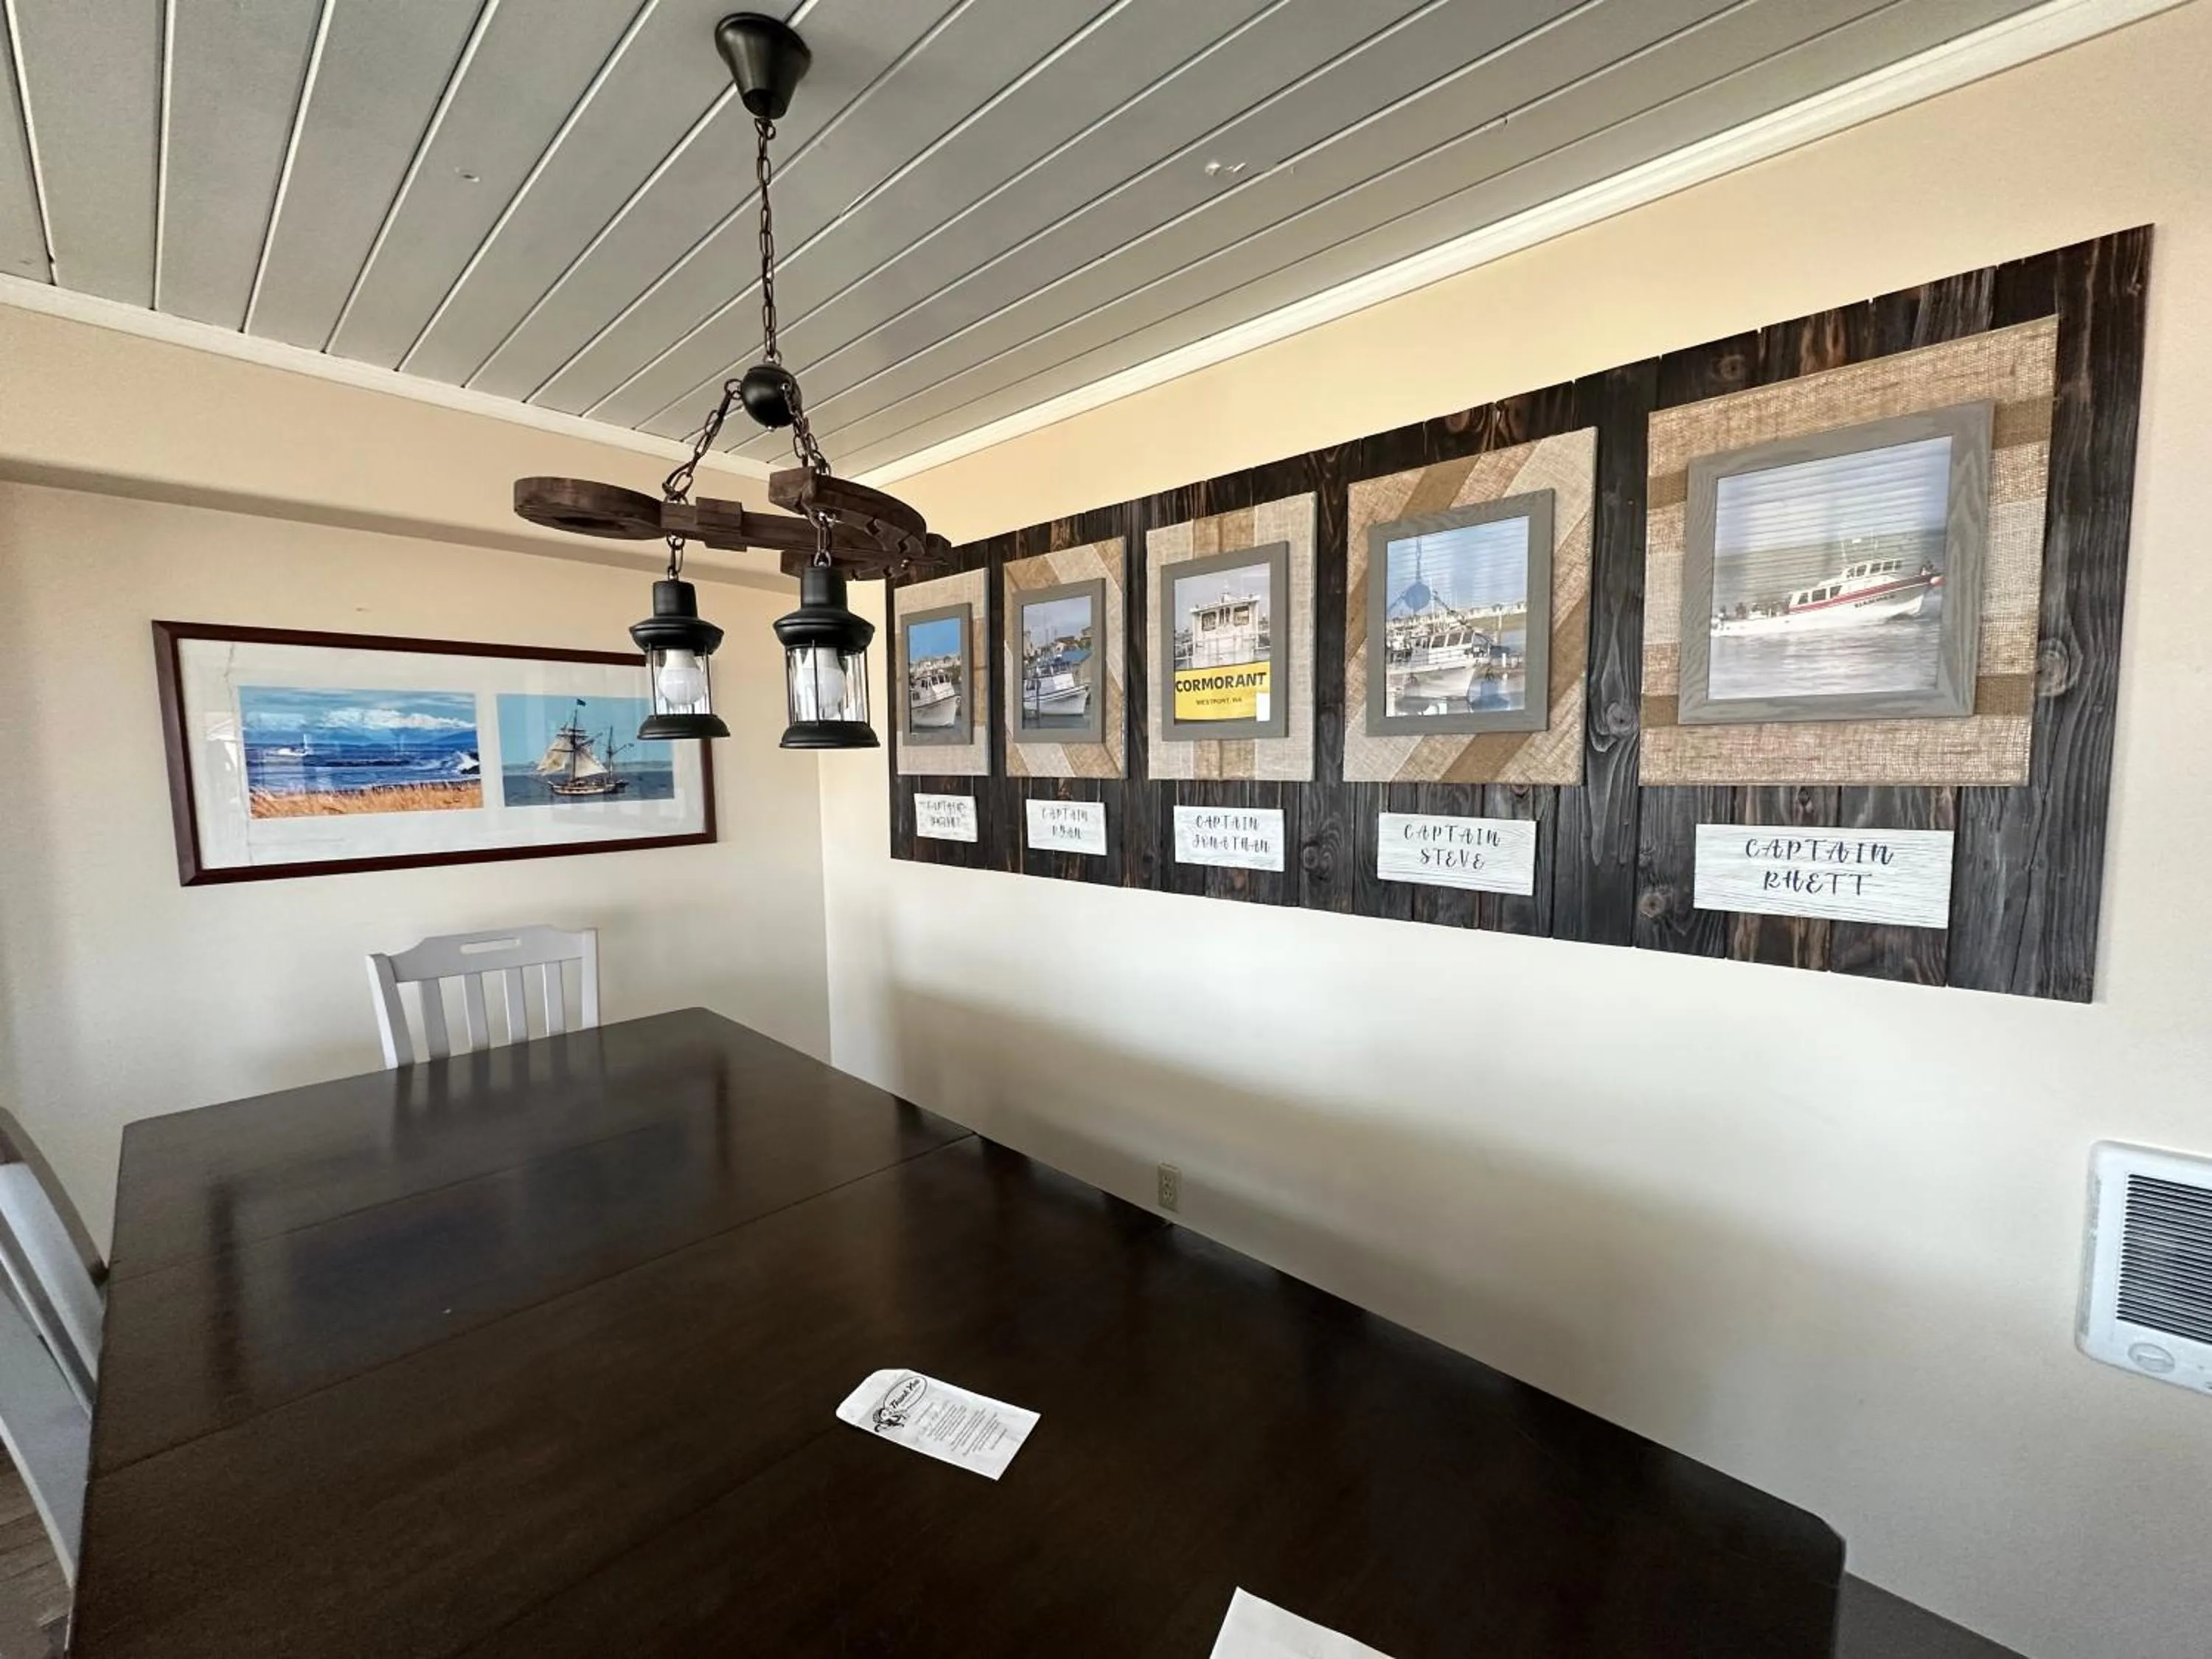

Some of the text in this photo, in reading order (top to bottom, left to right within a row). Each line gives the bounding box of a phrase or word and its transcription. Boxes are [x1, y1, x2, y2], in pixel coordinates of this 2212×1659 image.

[1175, 672, 1267, 693] CORMORANT
[1196, 814, 1259, 831] CAPTAIN
[1404, 824, 1500, 847] CAPTAIN
[1420, 847, 1485, 869] STEVE
[1745, 838, 1894, 865] CAPTAIN
[1764, 870, 1873, 896] RHETT
